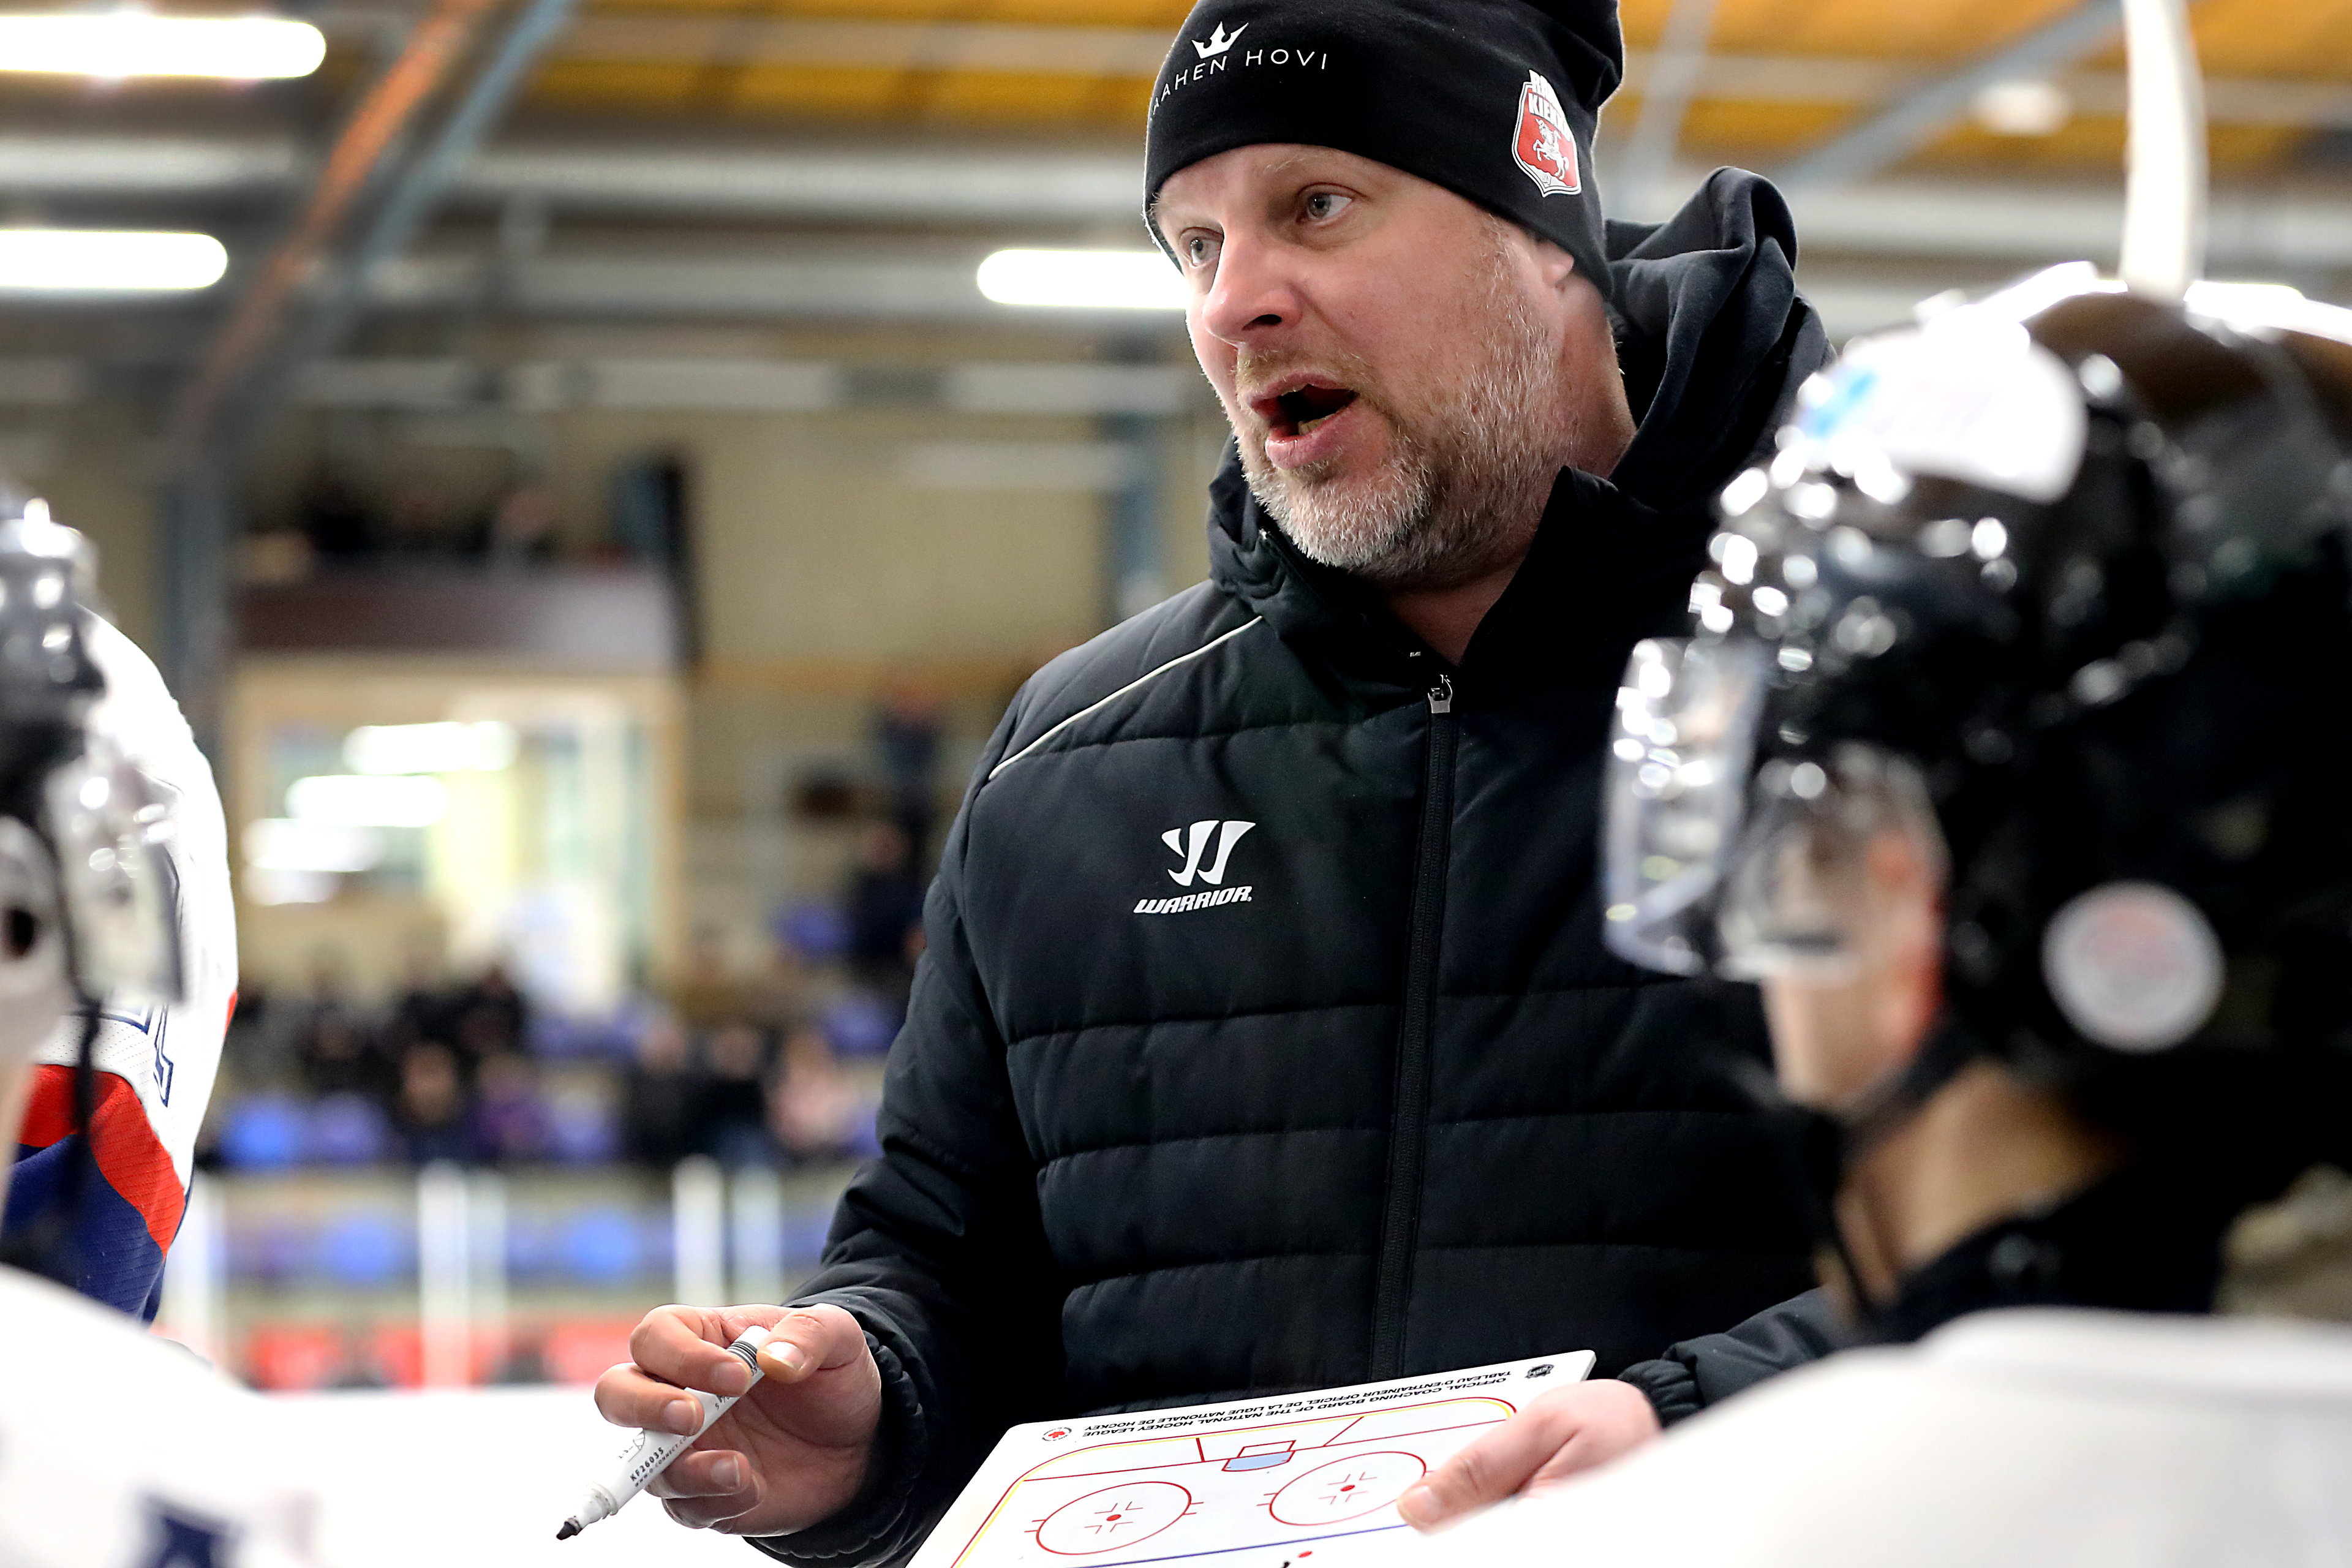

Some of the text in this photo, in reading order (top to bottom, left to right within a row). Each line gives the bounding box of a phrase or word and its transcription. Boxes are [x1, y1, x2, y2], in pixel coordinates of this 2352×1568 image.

[1150, 49, 1327, 120] AAHEN HOVI
[1133, 886, 1253, 914] WARRIOR
[1457, 1371, 1512, 1384] TABLEAU
[1446, 1378, 1506, 1390] OFFICIAL
[1307, 1393, 1360, 1404] OFFICIEL
[1369, 1387, 1442, 1402] COACHING
[1317, 1398, 1365, 1409] BOARD
[1229, 1406, 1264, 1415] LIGUE
[1159, 1411, 1225, 1423] NATIONALE
[1197, 1413, 1262, 1424] NATIONAL
[1085, 1421, 1136, 1431] HOCKEY
[1137, 1421, 1193, 1431] HOCKEY
[1082, 1427, 1134, 1437] LEAGUE
[630, 1447, 664, 1482] KF26035
